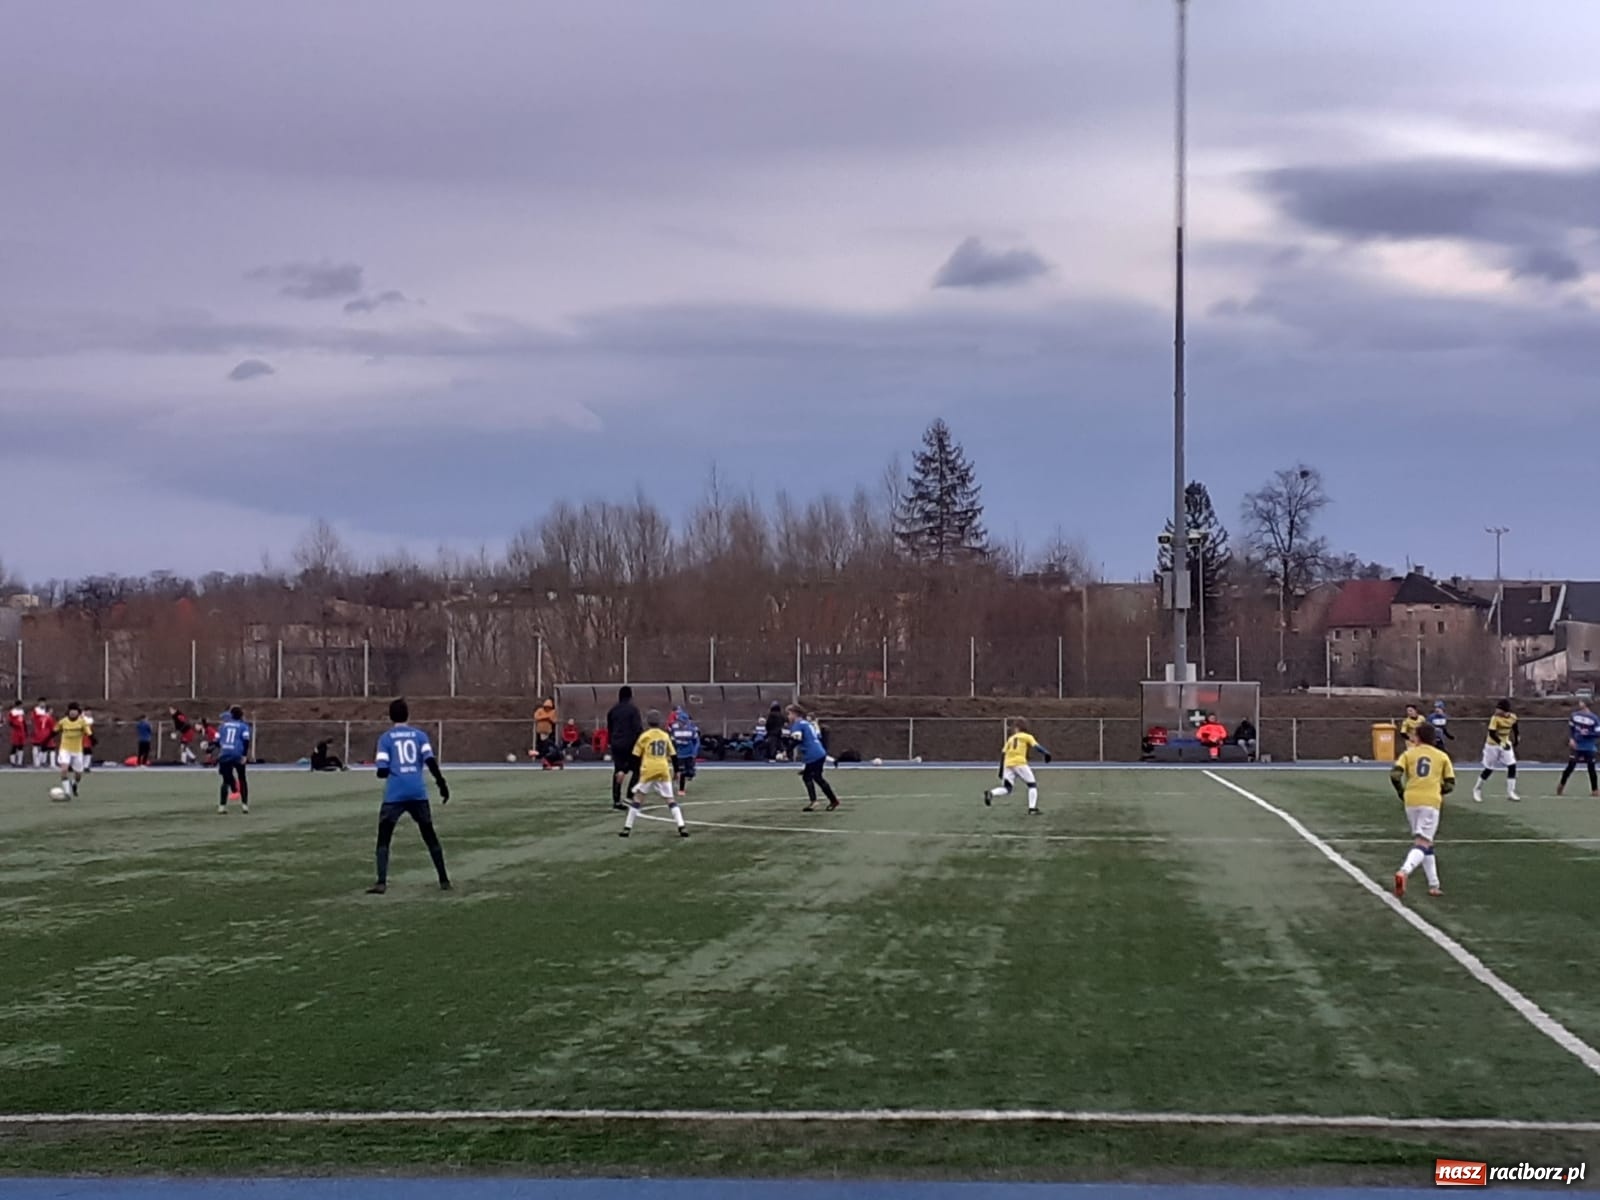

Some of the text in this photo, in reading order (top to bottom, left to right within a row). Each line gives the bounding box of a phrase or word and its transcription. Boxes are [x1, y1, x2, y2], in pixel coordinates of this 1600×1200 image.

[226, 727, 237, 744] 11
[394, 739, 417, 764] 10
[1416, 755, 1431, 778] 6
